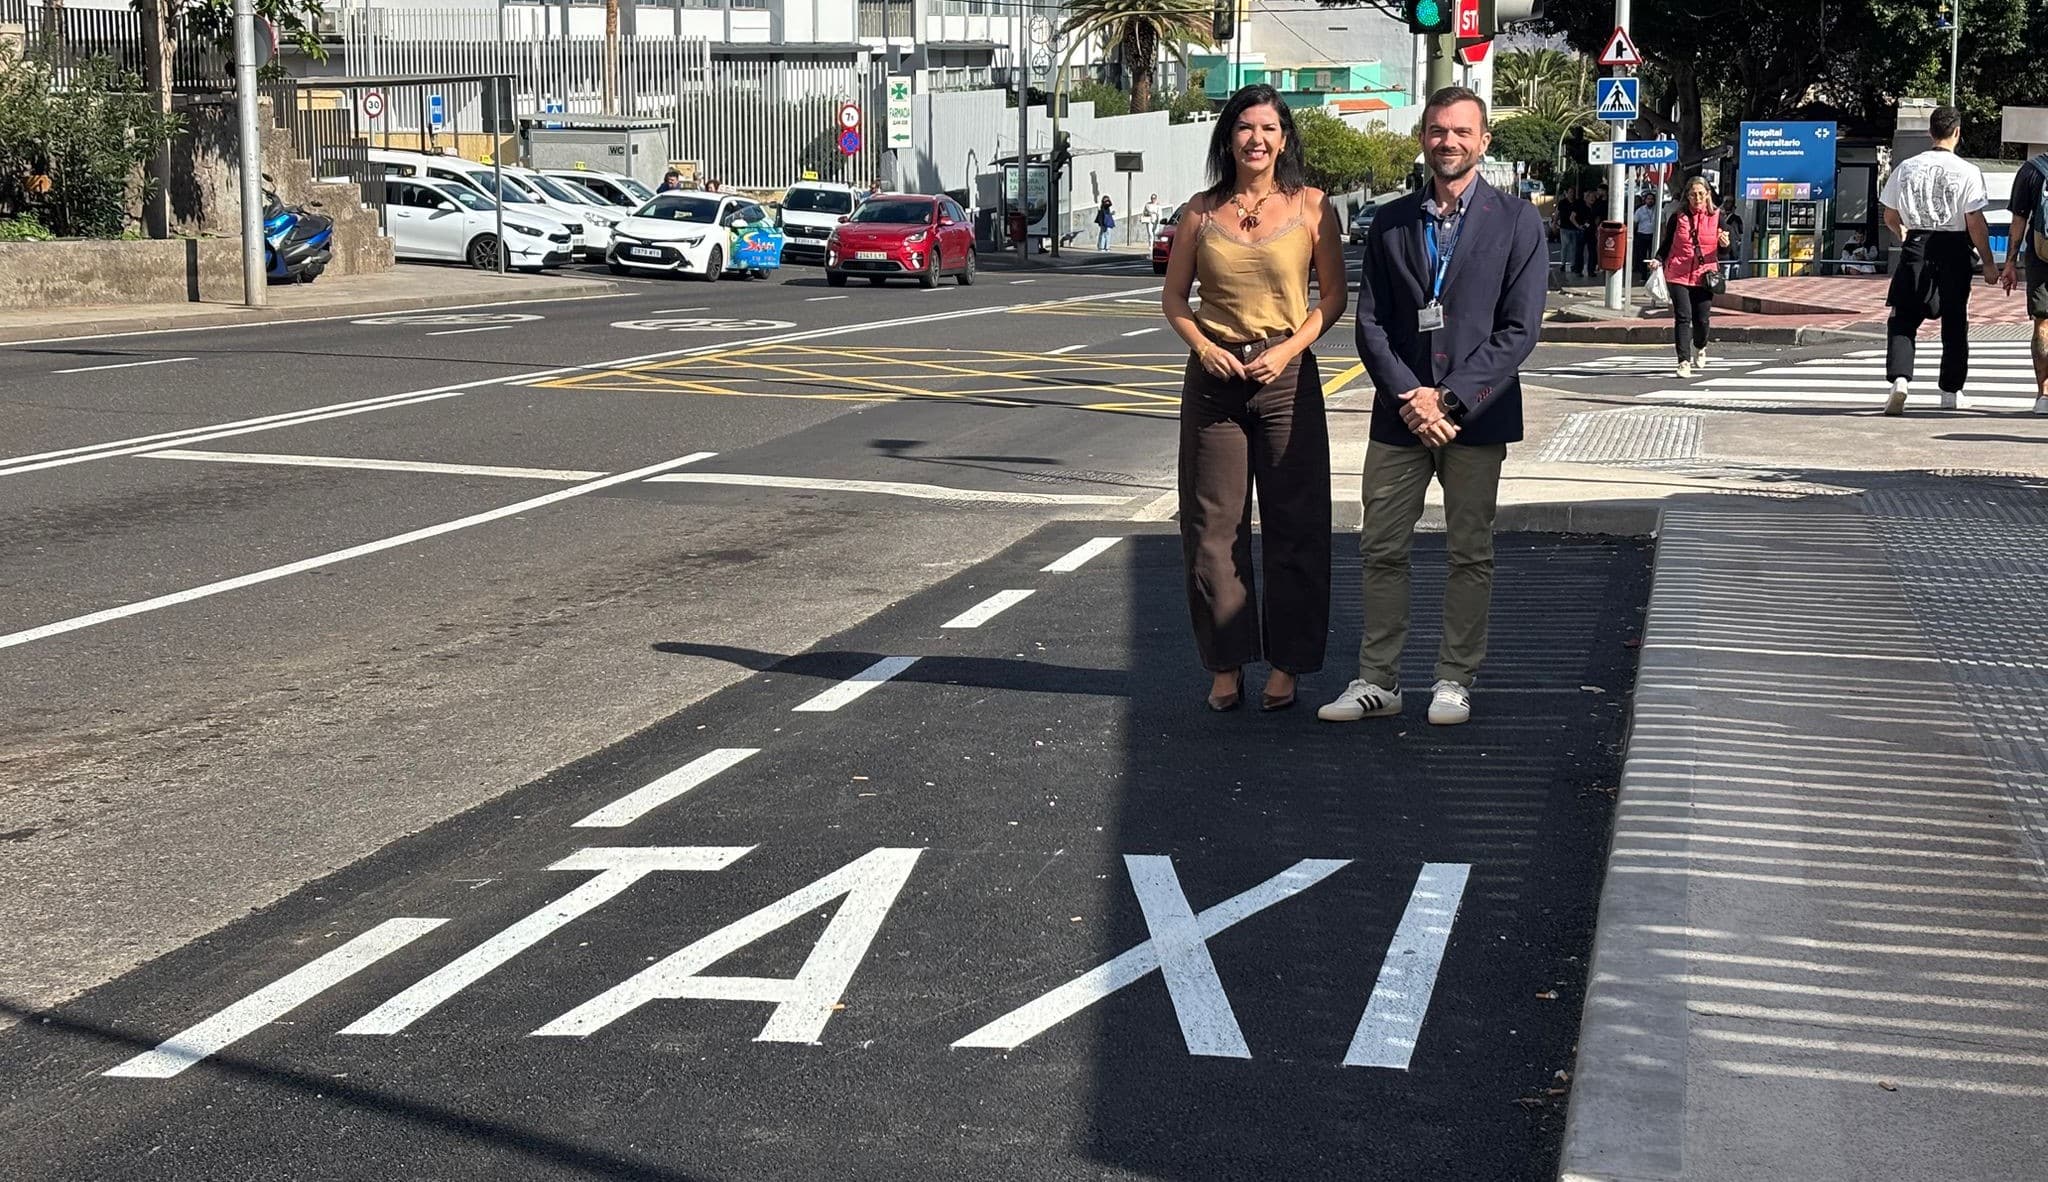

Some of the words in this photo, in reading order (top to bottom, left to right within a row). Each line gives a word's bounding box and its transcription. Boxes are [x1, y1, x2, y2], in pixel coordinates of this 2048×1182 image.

[1462, 10, 1478, 31] ST
[368, 101, 379, 109] 30
[1747, 128, 1782, 138] Hospital
[1747, 138, 1800, 147] Universitario
[609, 146, 625, 155] WC
[1613, 146, 1664, 160] Entrada
[1750, 188, 1759, 196] A1
[1781, 187, 1792, 195] A3
[1796, 187, 1808, 195] A4
[340, 847, 1471, 1069] TAXI
